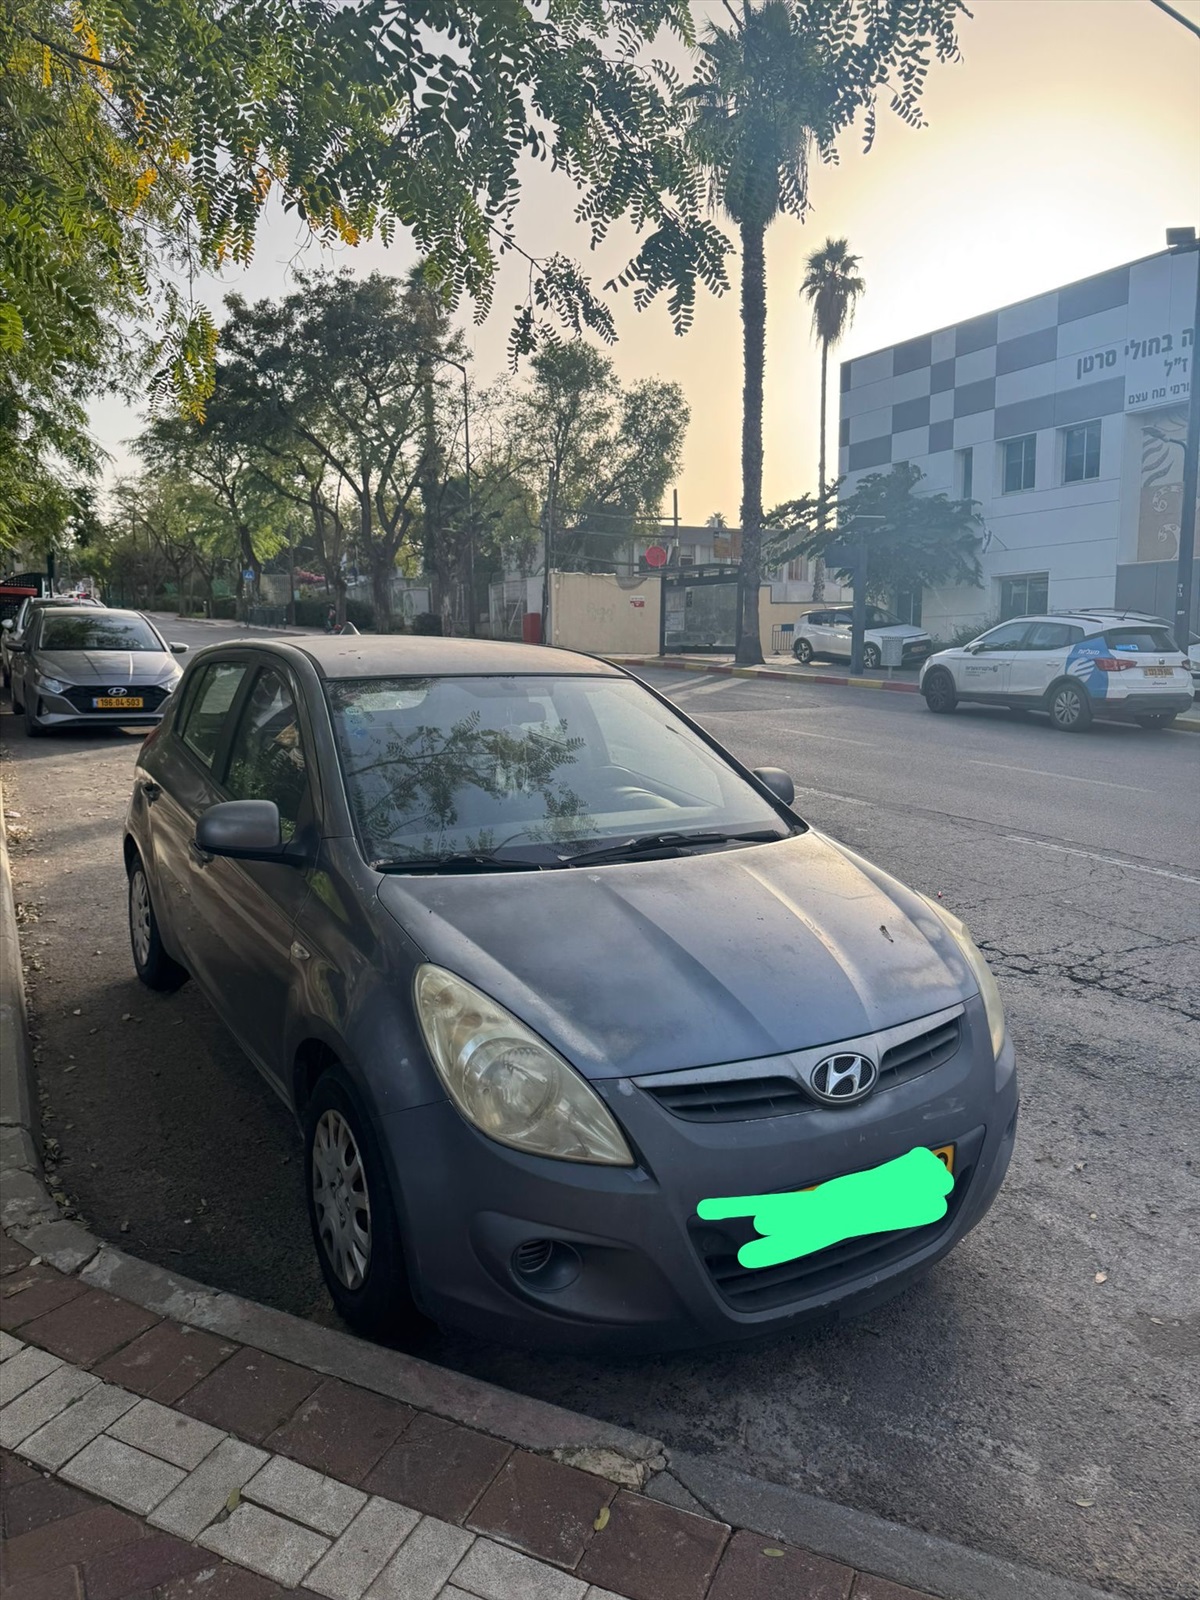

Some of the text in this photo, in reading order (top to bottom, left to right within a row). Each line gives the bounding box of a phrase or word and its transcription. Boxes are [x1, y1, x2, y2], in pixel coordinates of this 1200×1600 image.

[1076, 328, 1194, 380] ה בחולי סרטן
[1128, 382, 1190, 405] ורמי מח עצם
